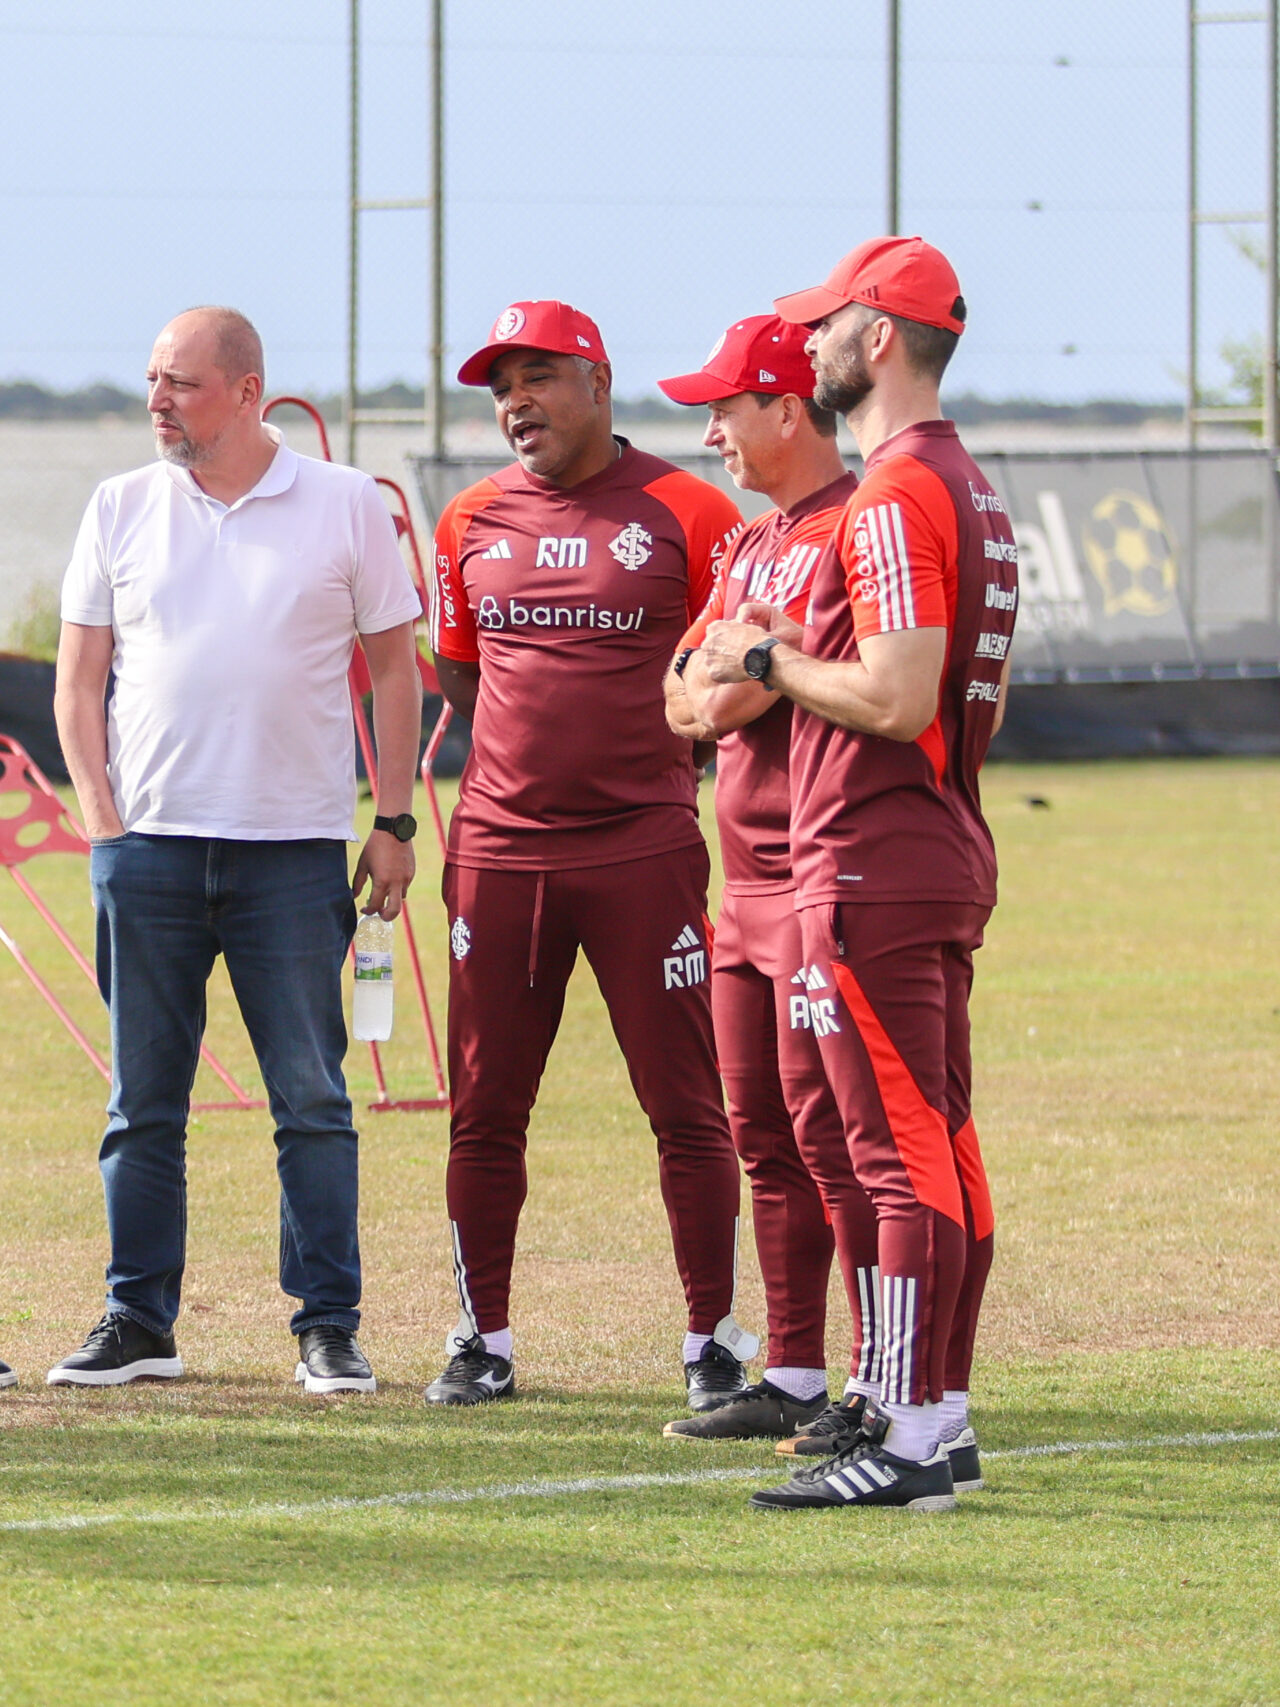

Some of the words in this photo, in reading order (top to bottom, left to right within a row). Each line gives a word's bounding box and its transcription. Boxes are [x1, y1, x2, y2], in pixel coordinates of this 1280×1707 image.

[535, 537, 588, 569] RM
[853, 510, 874, 577] vero
[510, 600, 644, 631] banrisul
[662, 949, 706, 991] RM
